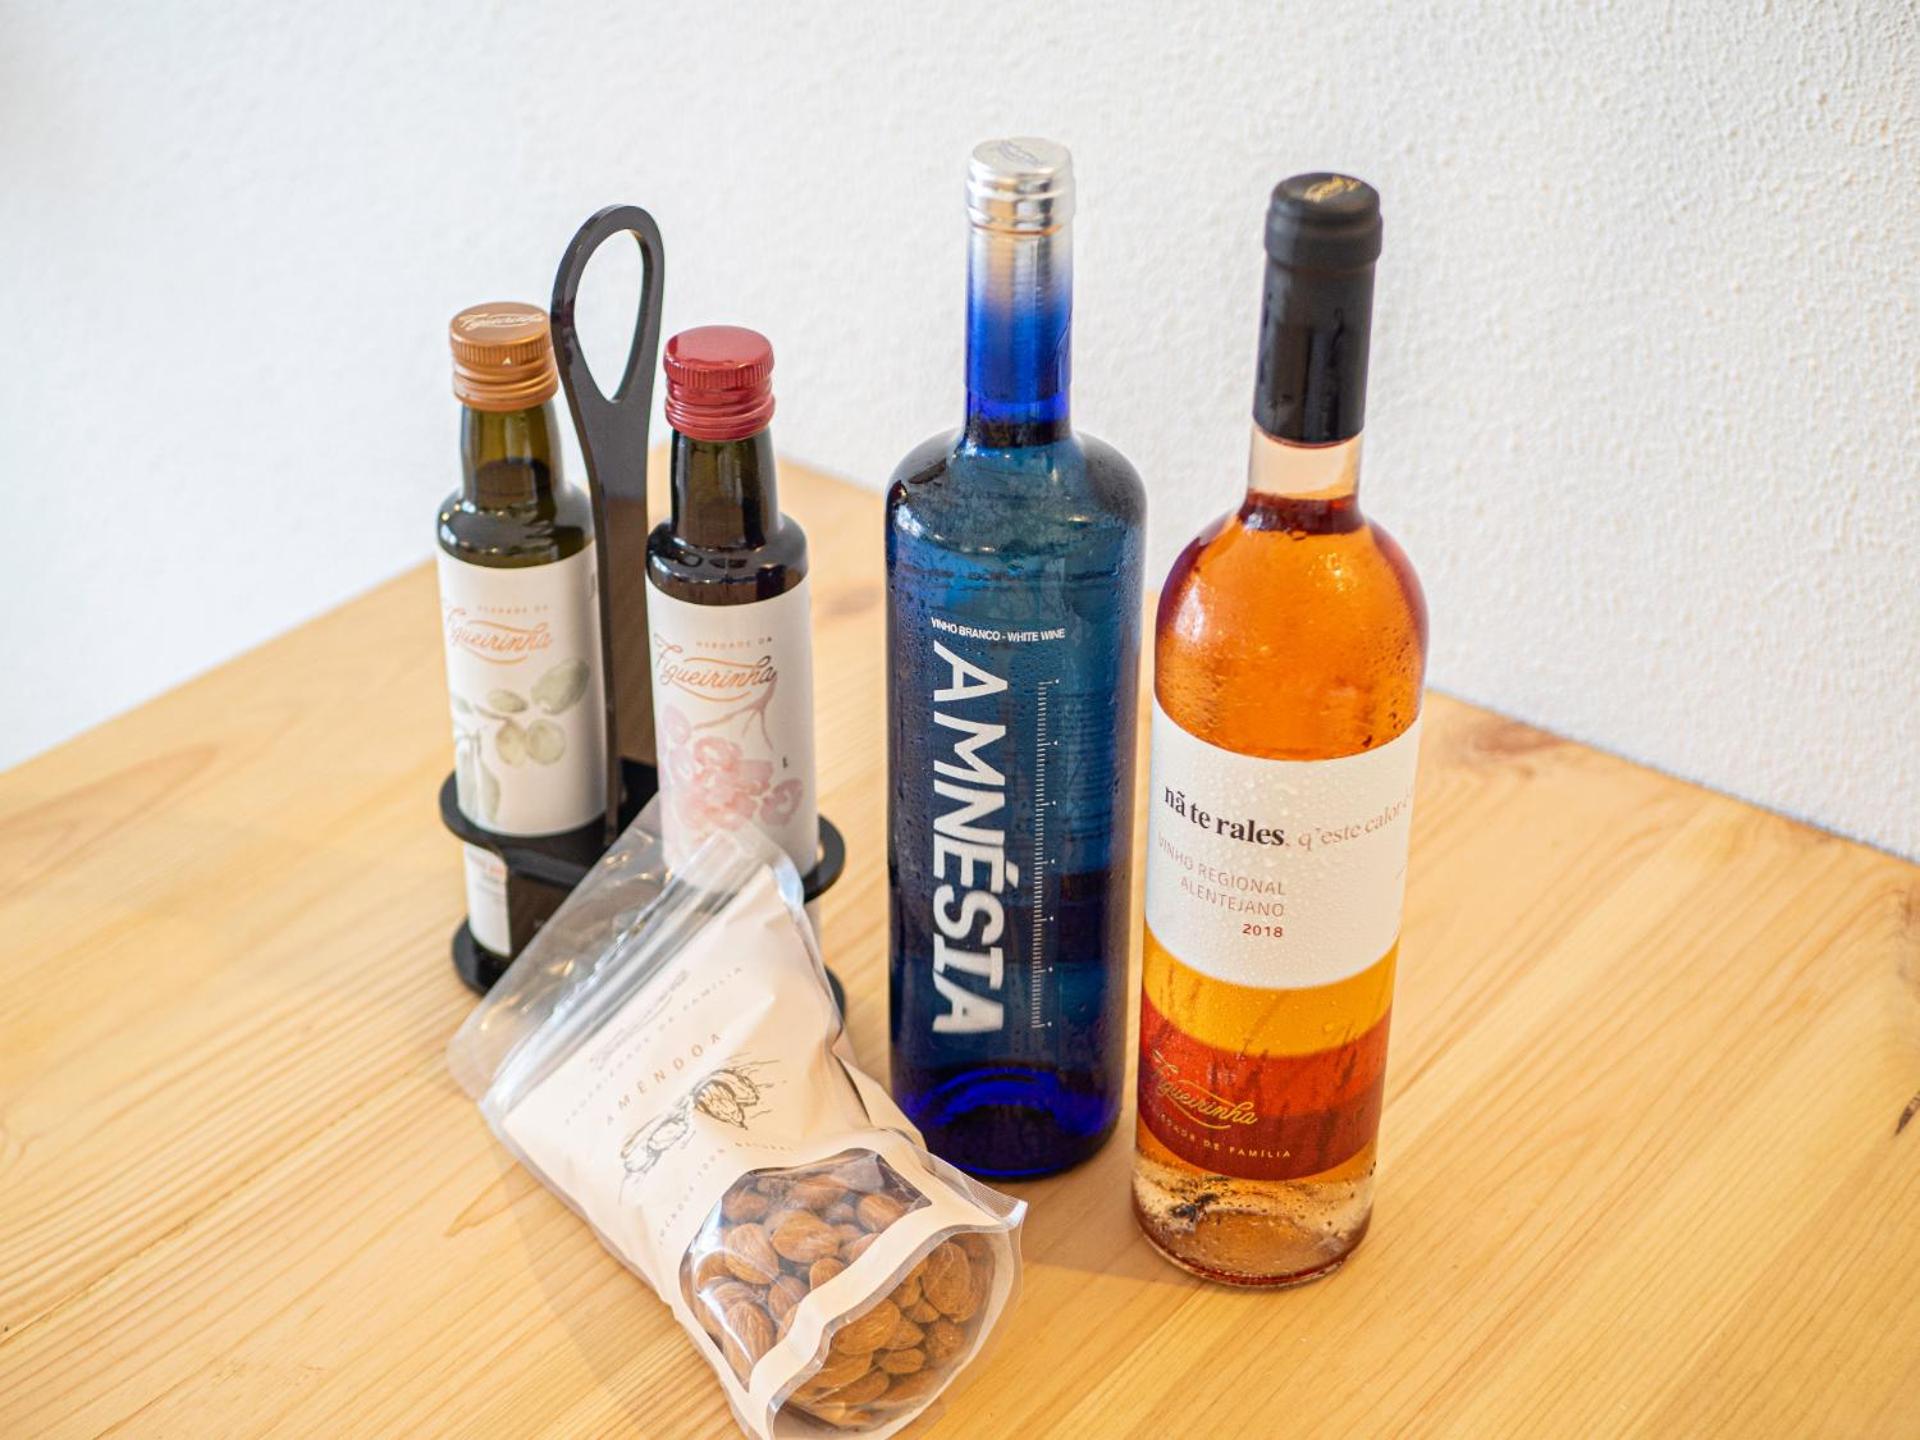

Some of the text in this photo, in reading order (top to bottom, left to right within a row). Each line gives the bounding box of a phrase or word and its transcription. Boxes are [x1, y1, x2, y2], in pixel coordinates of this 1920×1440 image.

[931, 617, 958, 633] VINHO
[959, 625, 1000, 640] BRANCO
[1007, 631, 1039, 642] WHITE
[1040, 628, 1065, 640] WINE
[933, 640, 1018, 1034] AMNÉSIA
[1158, 831, 1286, 896] VINHO REGIONAL
[1180, 876, 1284, 917] ALENTEJANO
[1242, 923, 1283, 938] 2018
